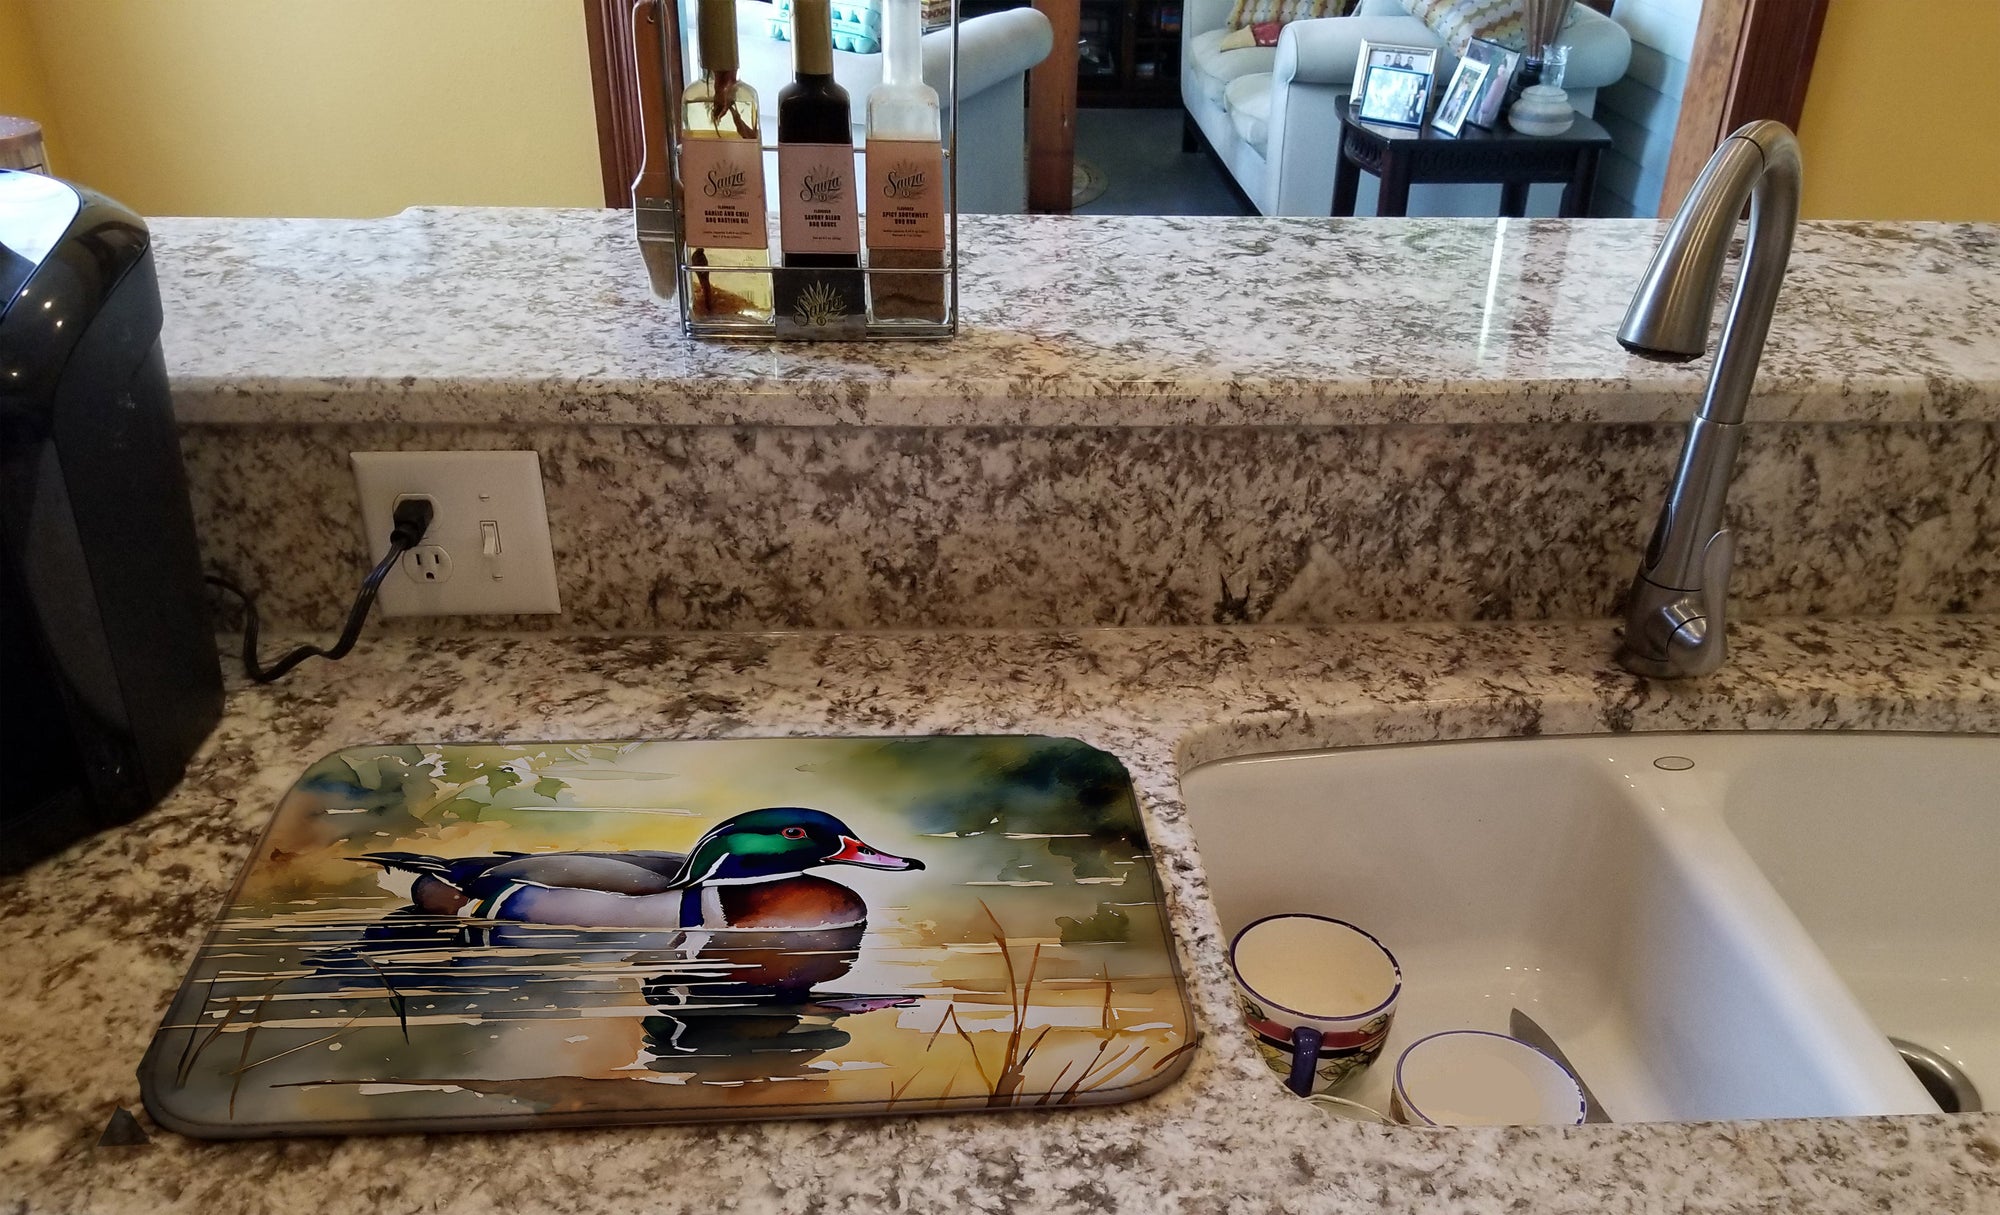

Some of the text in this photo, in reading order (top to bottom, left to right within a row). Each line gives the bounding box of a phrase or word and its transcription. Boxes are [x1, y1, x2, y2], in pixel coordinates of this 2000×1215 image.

[703, 170, 745, 197] Sauza
[799, 175, 841, 202] Sauza
[883, 171, 925, 198] Sauza
[793, 294, 847, 326] Sauza
